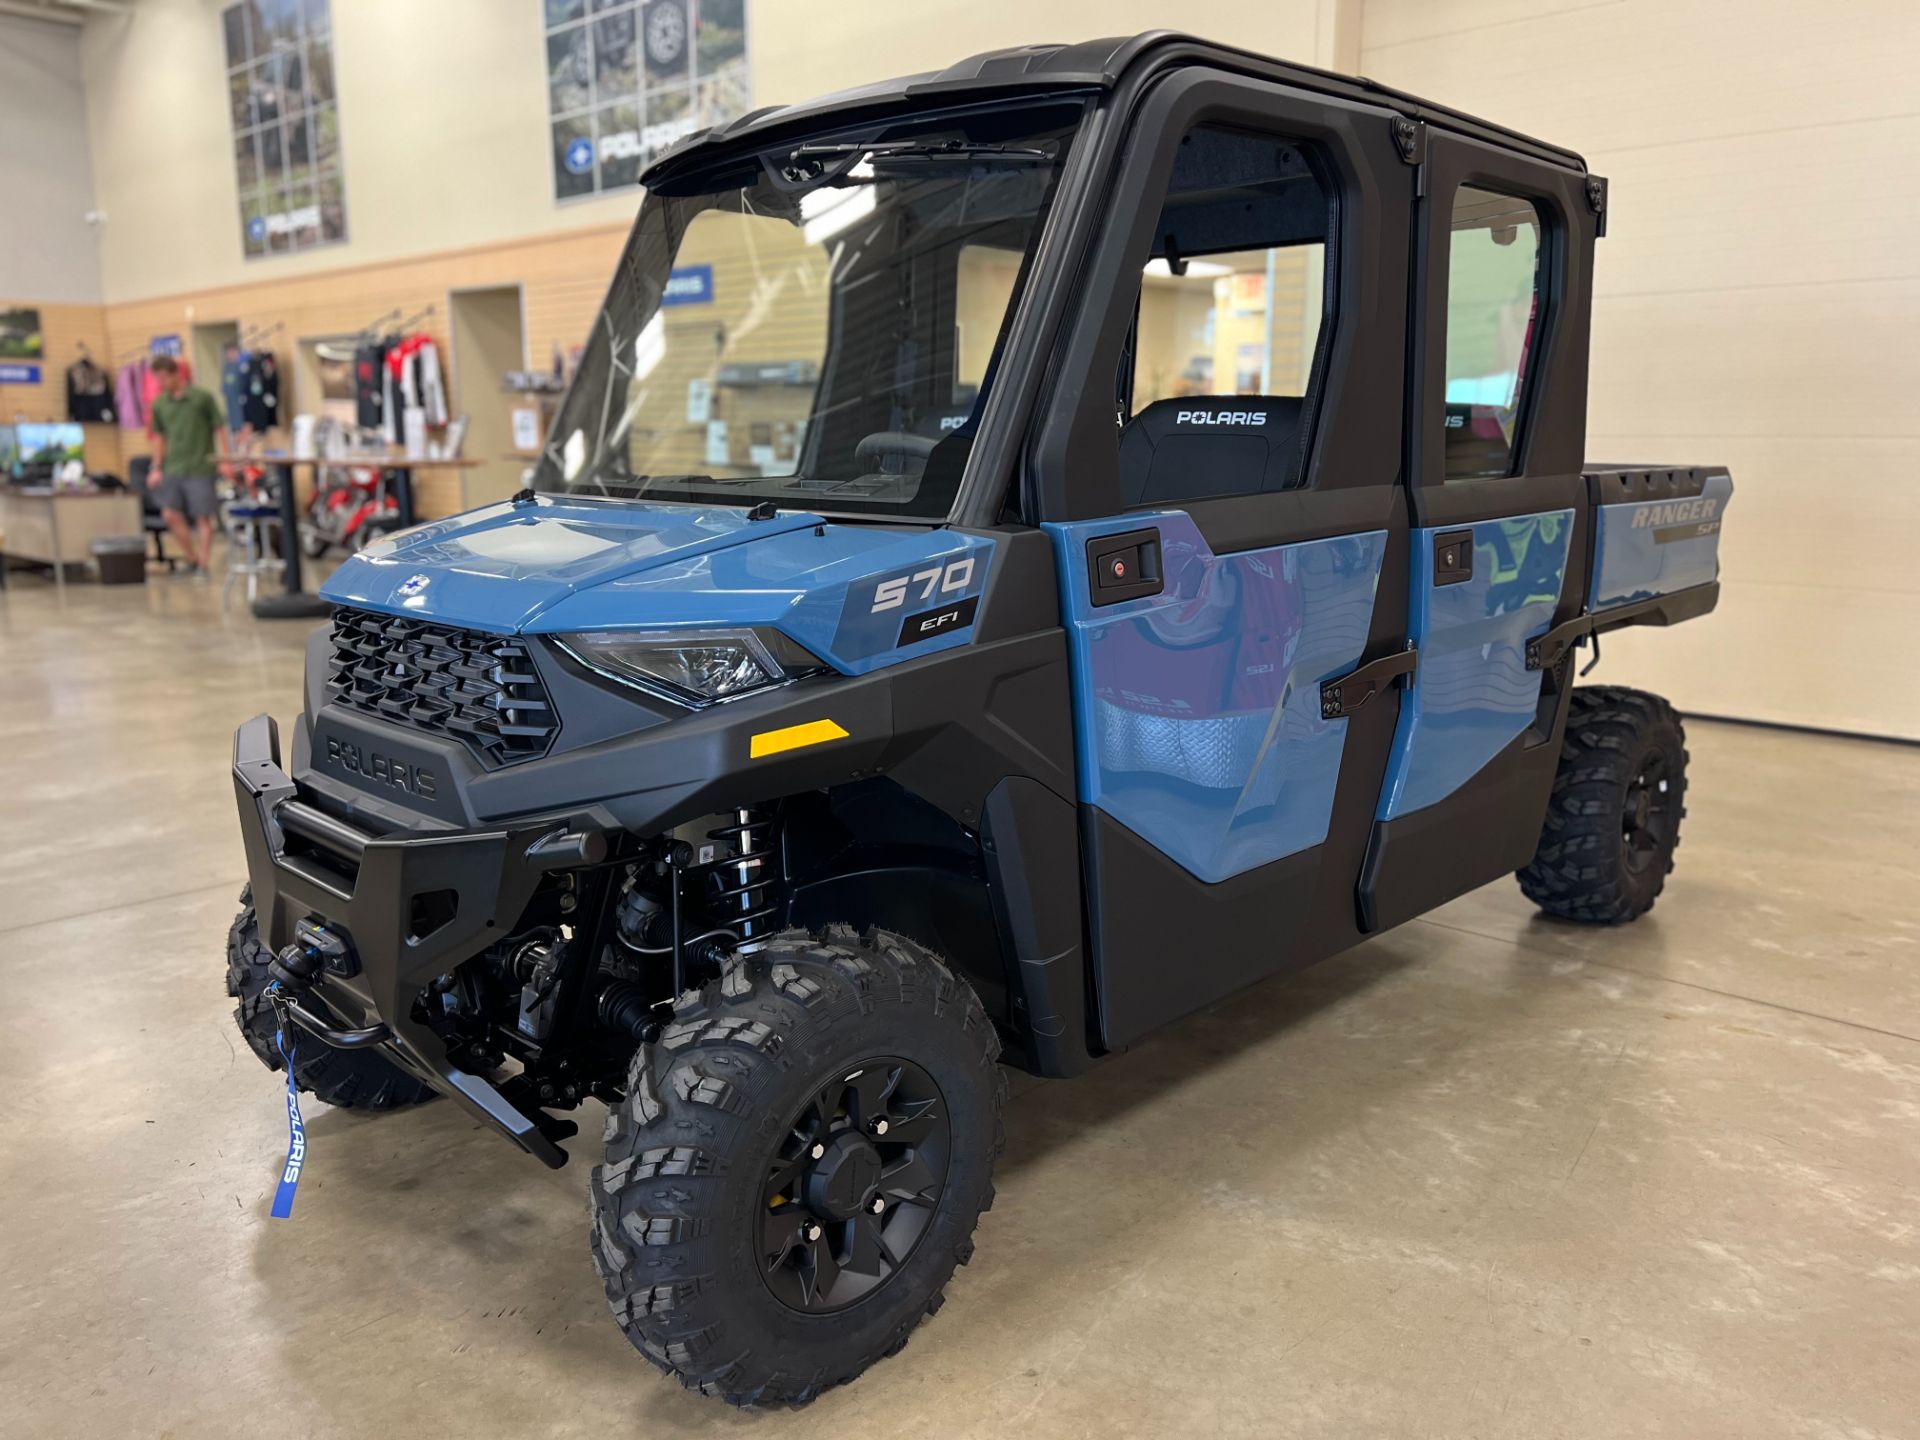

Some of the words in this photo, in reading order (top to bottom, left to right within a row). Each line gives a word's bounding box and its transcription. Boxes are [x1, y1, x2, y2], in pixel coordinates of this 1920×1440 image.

[1176, 410, 1267, 426] POLARIS
[1631, 498, 1717, 530] RANGER
[870, 557, 975, 614] 570
[919, 611, 959, 632] EFI
[326, 736, 437, 801] POLARIS
[283, 1092, 304, 1184] POLARIS
